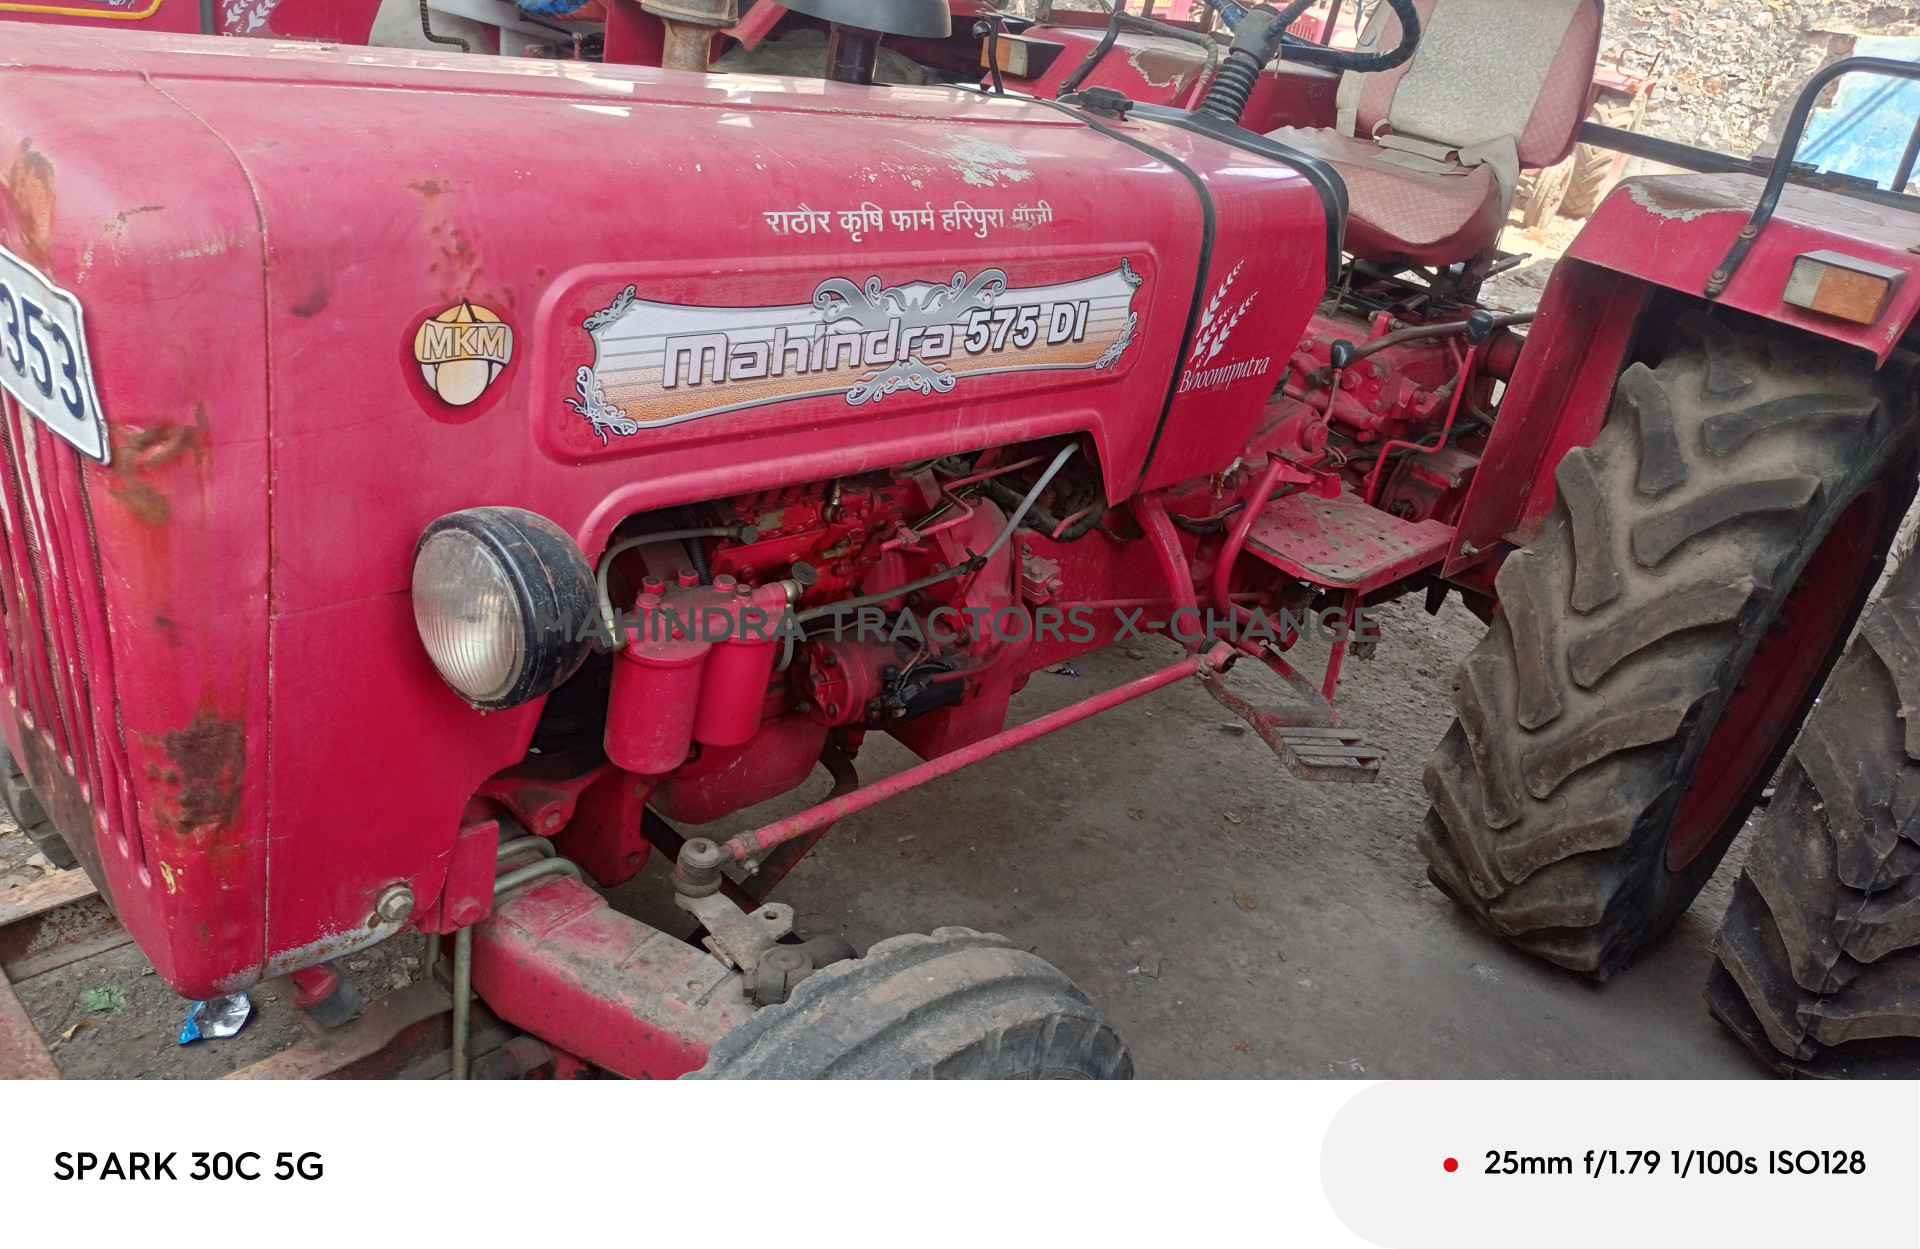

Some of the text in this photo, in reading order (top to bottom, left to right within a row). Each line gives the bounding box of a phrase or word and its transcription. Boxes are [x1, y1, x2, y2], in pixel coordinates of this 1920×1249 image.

[763, 202, 831, 236] राठौर
[836, 201, 883, 243] कृषि
[890, 201, 935, 232] फार्म
[939, 200, 1004, 239] हरिपुरा
[0, 277, 85, 420] 353
[422, 323, 506, 360] MKM
[964, 305, 1041, 354] 575
[1047, 300, 1091, 344] DI
[1177, 356, 1271, 394] Bhoomiputra
